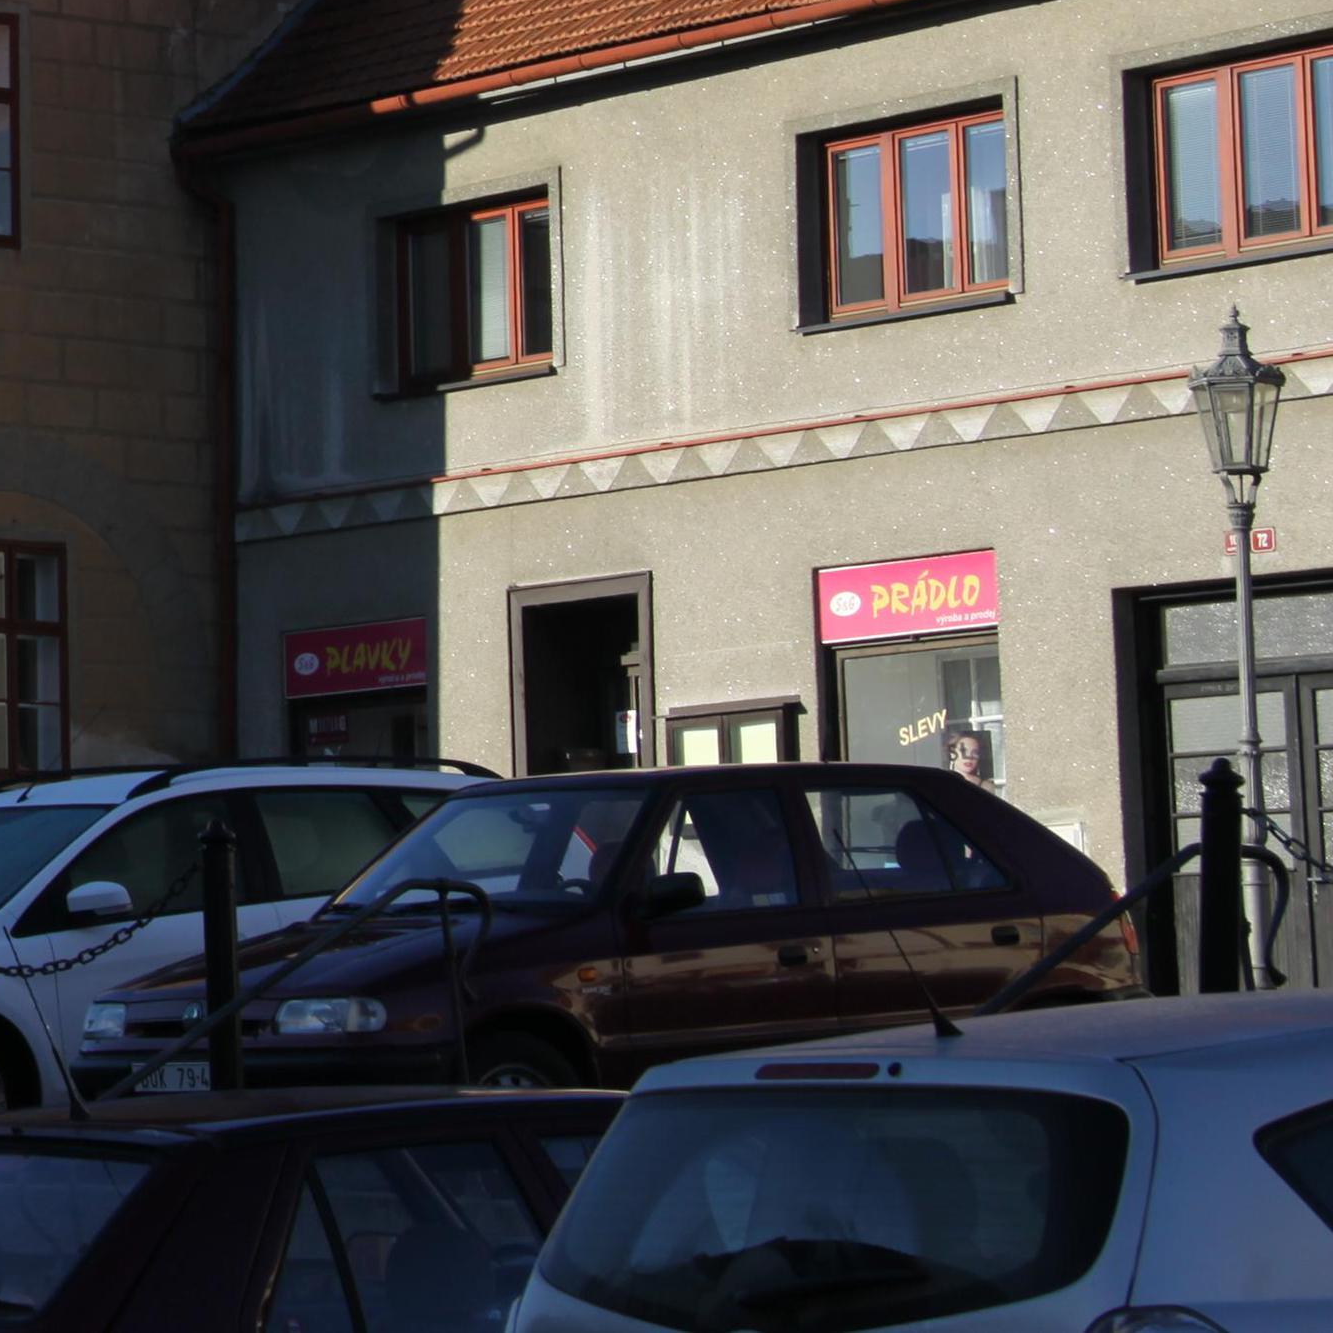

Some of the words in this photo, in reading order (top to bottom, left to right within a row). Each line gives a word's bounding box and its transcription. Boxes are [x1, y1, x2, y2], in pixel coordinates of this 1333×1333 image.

[870, 570, 981, 619] PRÁDLO
[324, 636, 412, 677] PLAVKY
[899, 709, 948, 746] SLEVY
